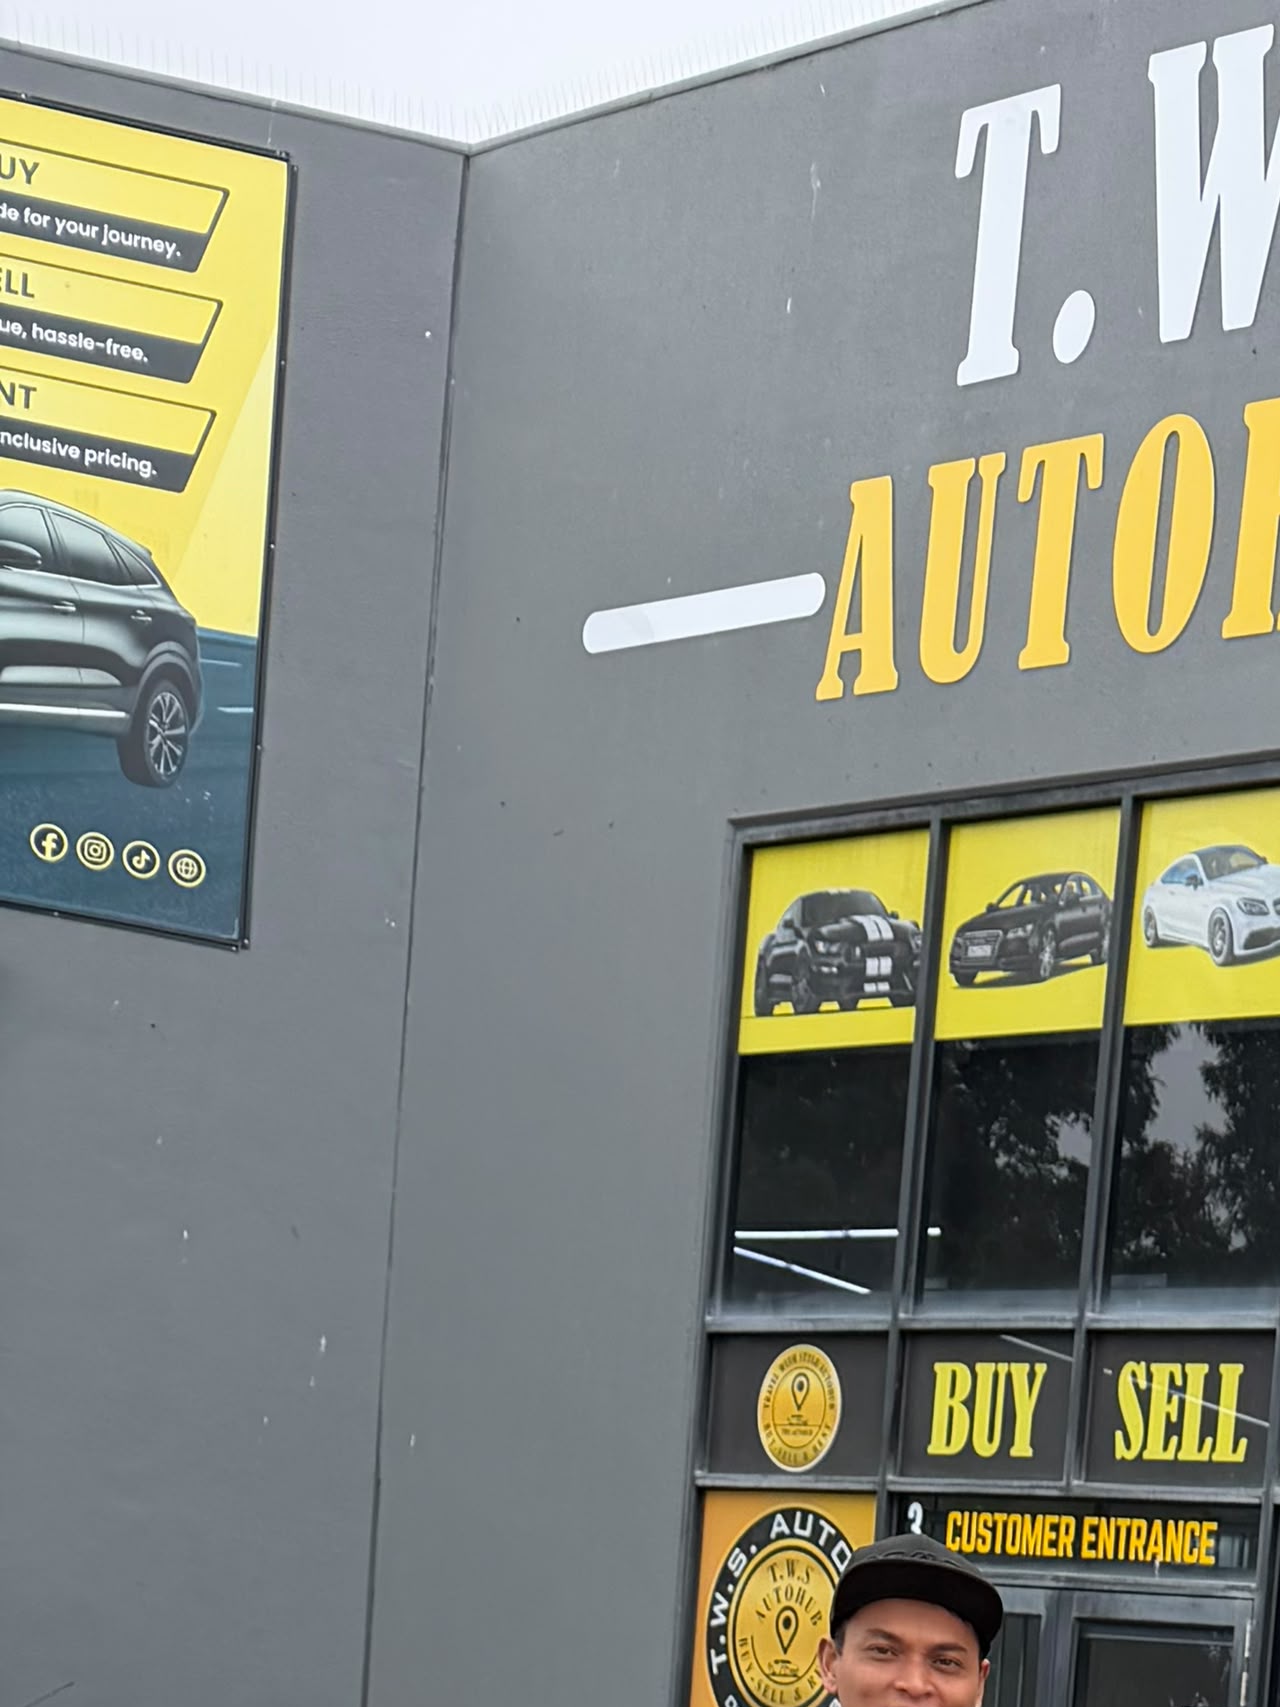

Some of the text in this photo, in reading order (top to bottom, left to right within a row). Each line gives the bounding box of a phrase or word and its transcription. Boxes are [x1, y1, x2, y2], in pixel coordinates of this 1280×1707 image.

[24, 207, 50, 227] for
[55, 217, 99, 237] your
[102, 224, 181, 259] journey.
[0, 268, 35, 298] LL
[32, 323, 148, 362] hassle-free.
[84, 449, 158, 478] pricing.
[927, 1362, 1047, 1458] BUY
[1114, 1361, 1247, 1462] SELL
[945, 1510, 1219, 1565] CUSTOMER ENTRANCE
